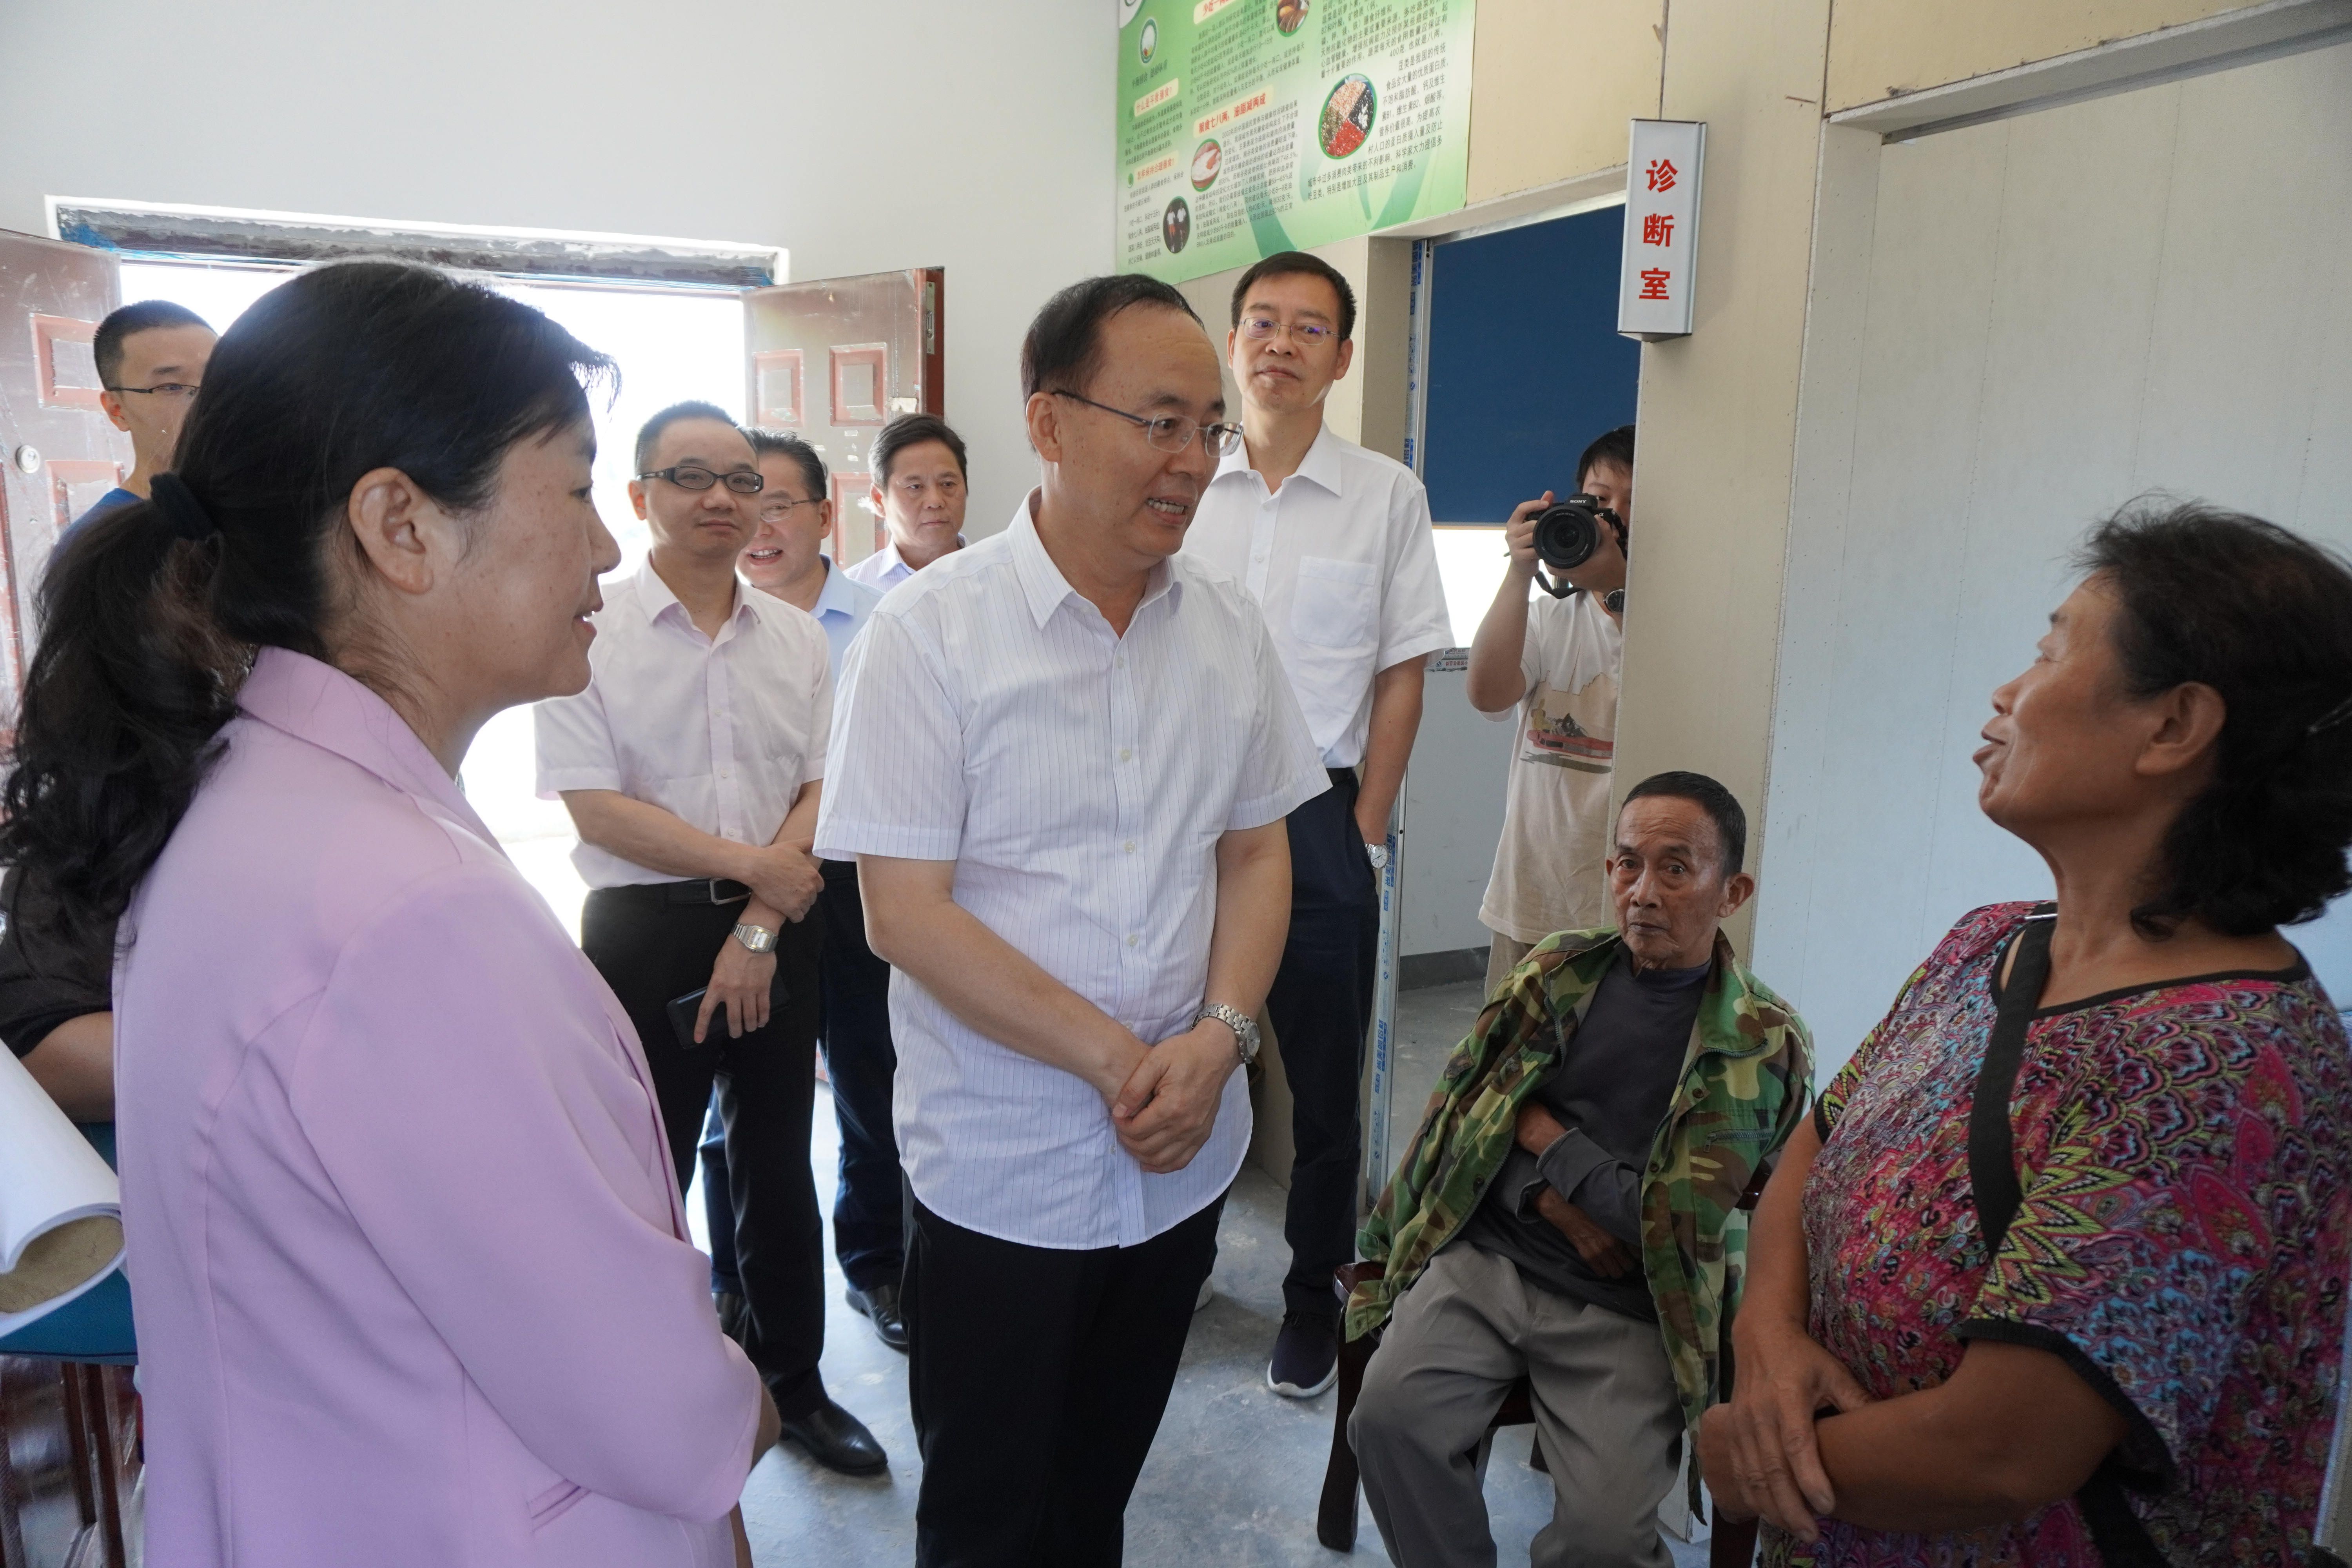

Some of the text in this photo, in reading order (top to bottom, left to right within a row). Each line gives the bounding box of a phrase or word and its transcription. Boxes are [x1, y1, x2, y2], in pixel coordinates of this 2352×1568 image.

[1398, 41, 1445, 71] 豆类是我国的传统
[1368, 119, 1442, 154] 村人口的蛋白质摄入量及防止
[1639, 159, 1678, 300] 诊断室
